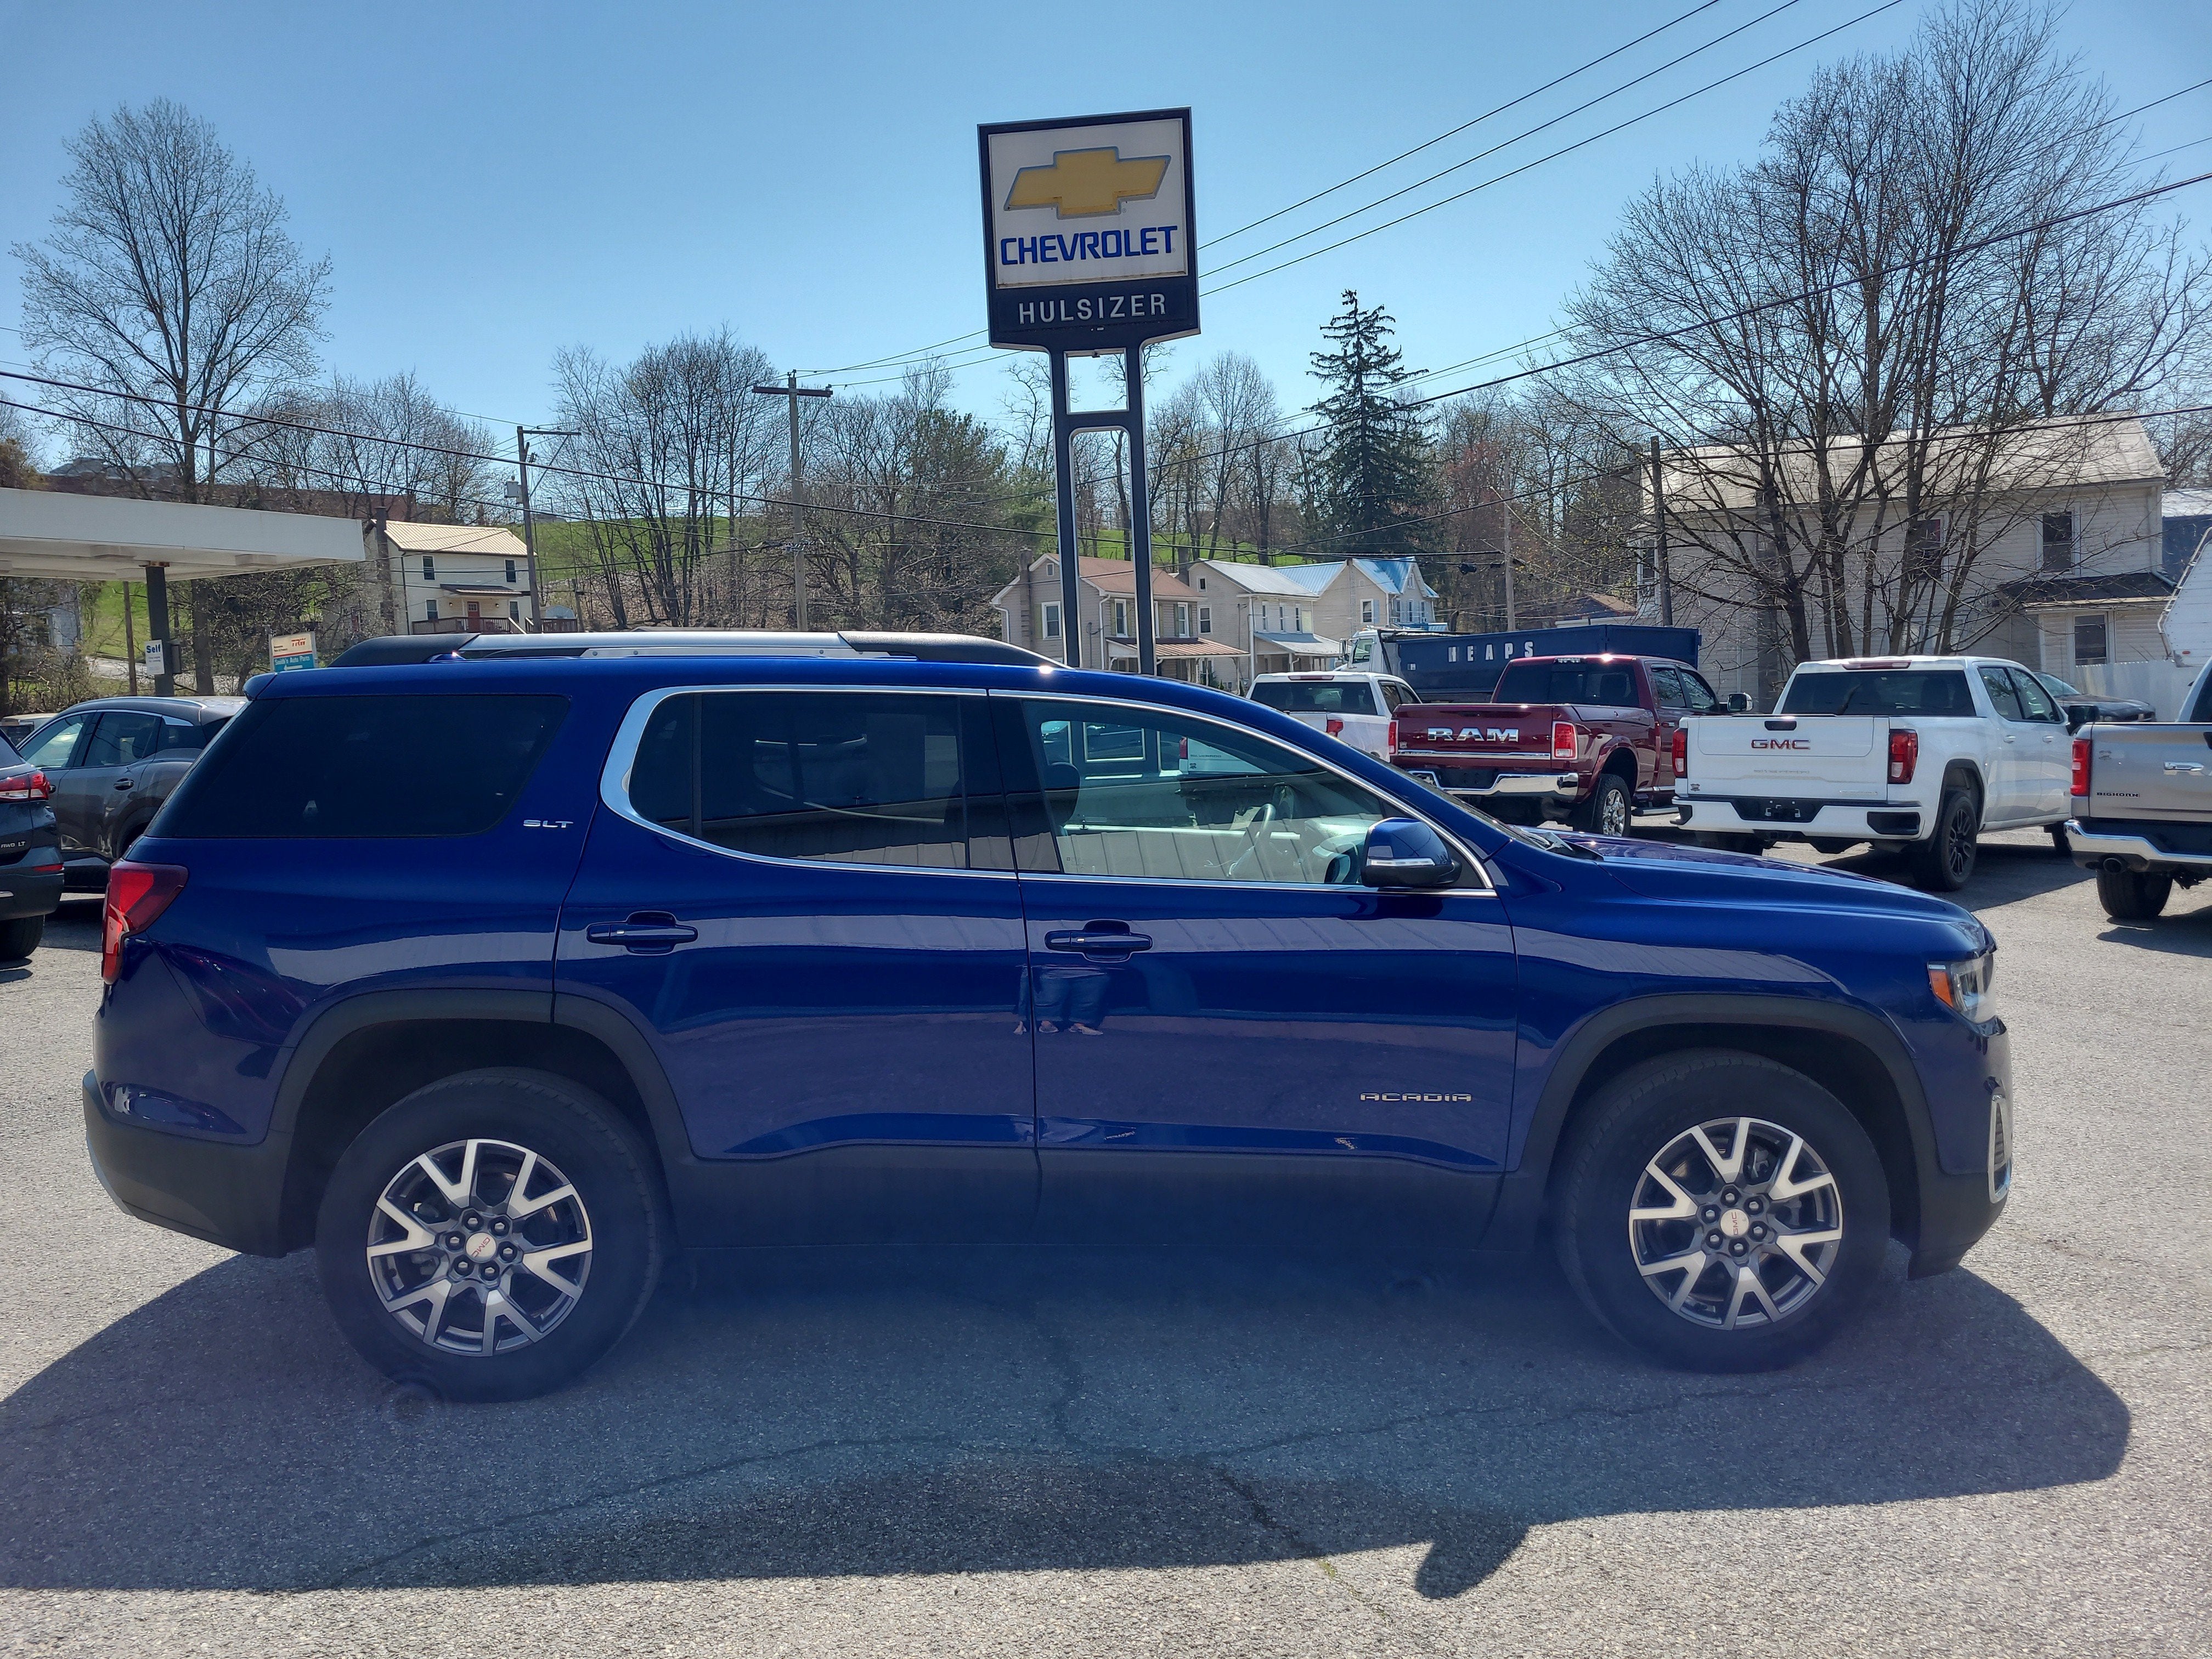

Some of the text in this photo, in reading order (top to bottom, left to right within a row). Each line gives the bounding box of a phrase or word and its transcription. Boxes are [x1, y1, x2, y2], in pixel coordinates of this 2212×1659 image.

[1000, 225, 1178, 266] CHEVROLET
[1018, 293, 1166, 325] HULSIZER
[146, 644, 161, 653] Self
[1448, 641, 1534, 663] HEAPS
[1427, 727, 1519, 742] RAM
[1751, 738, 1811, 750] GMC
[523, 819, 574, 828] SLT
[1360, 1093, 1472, 1102] ACADIA
[472, 1237, 490, 1258] GMC
